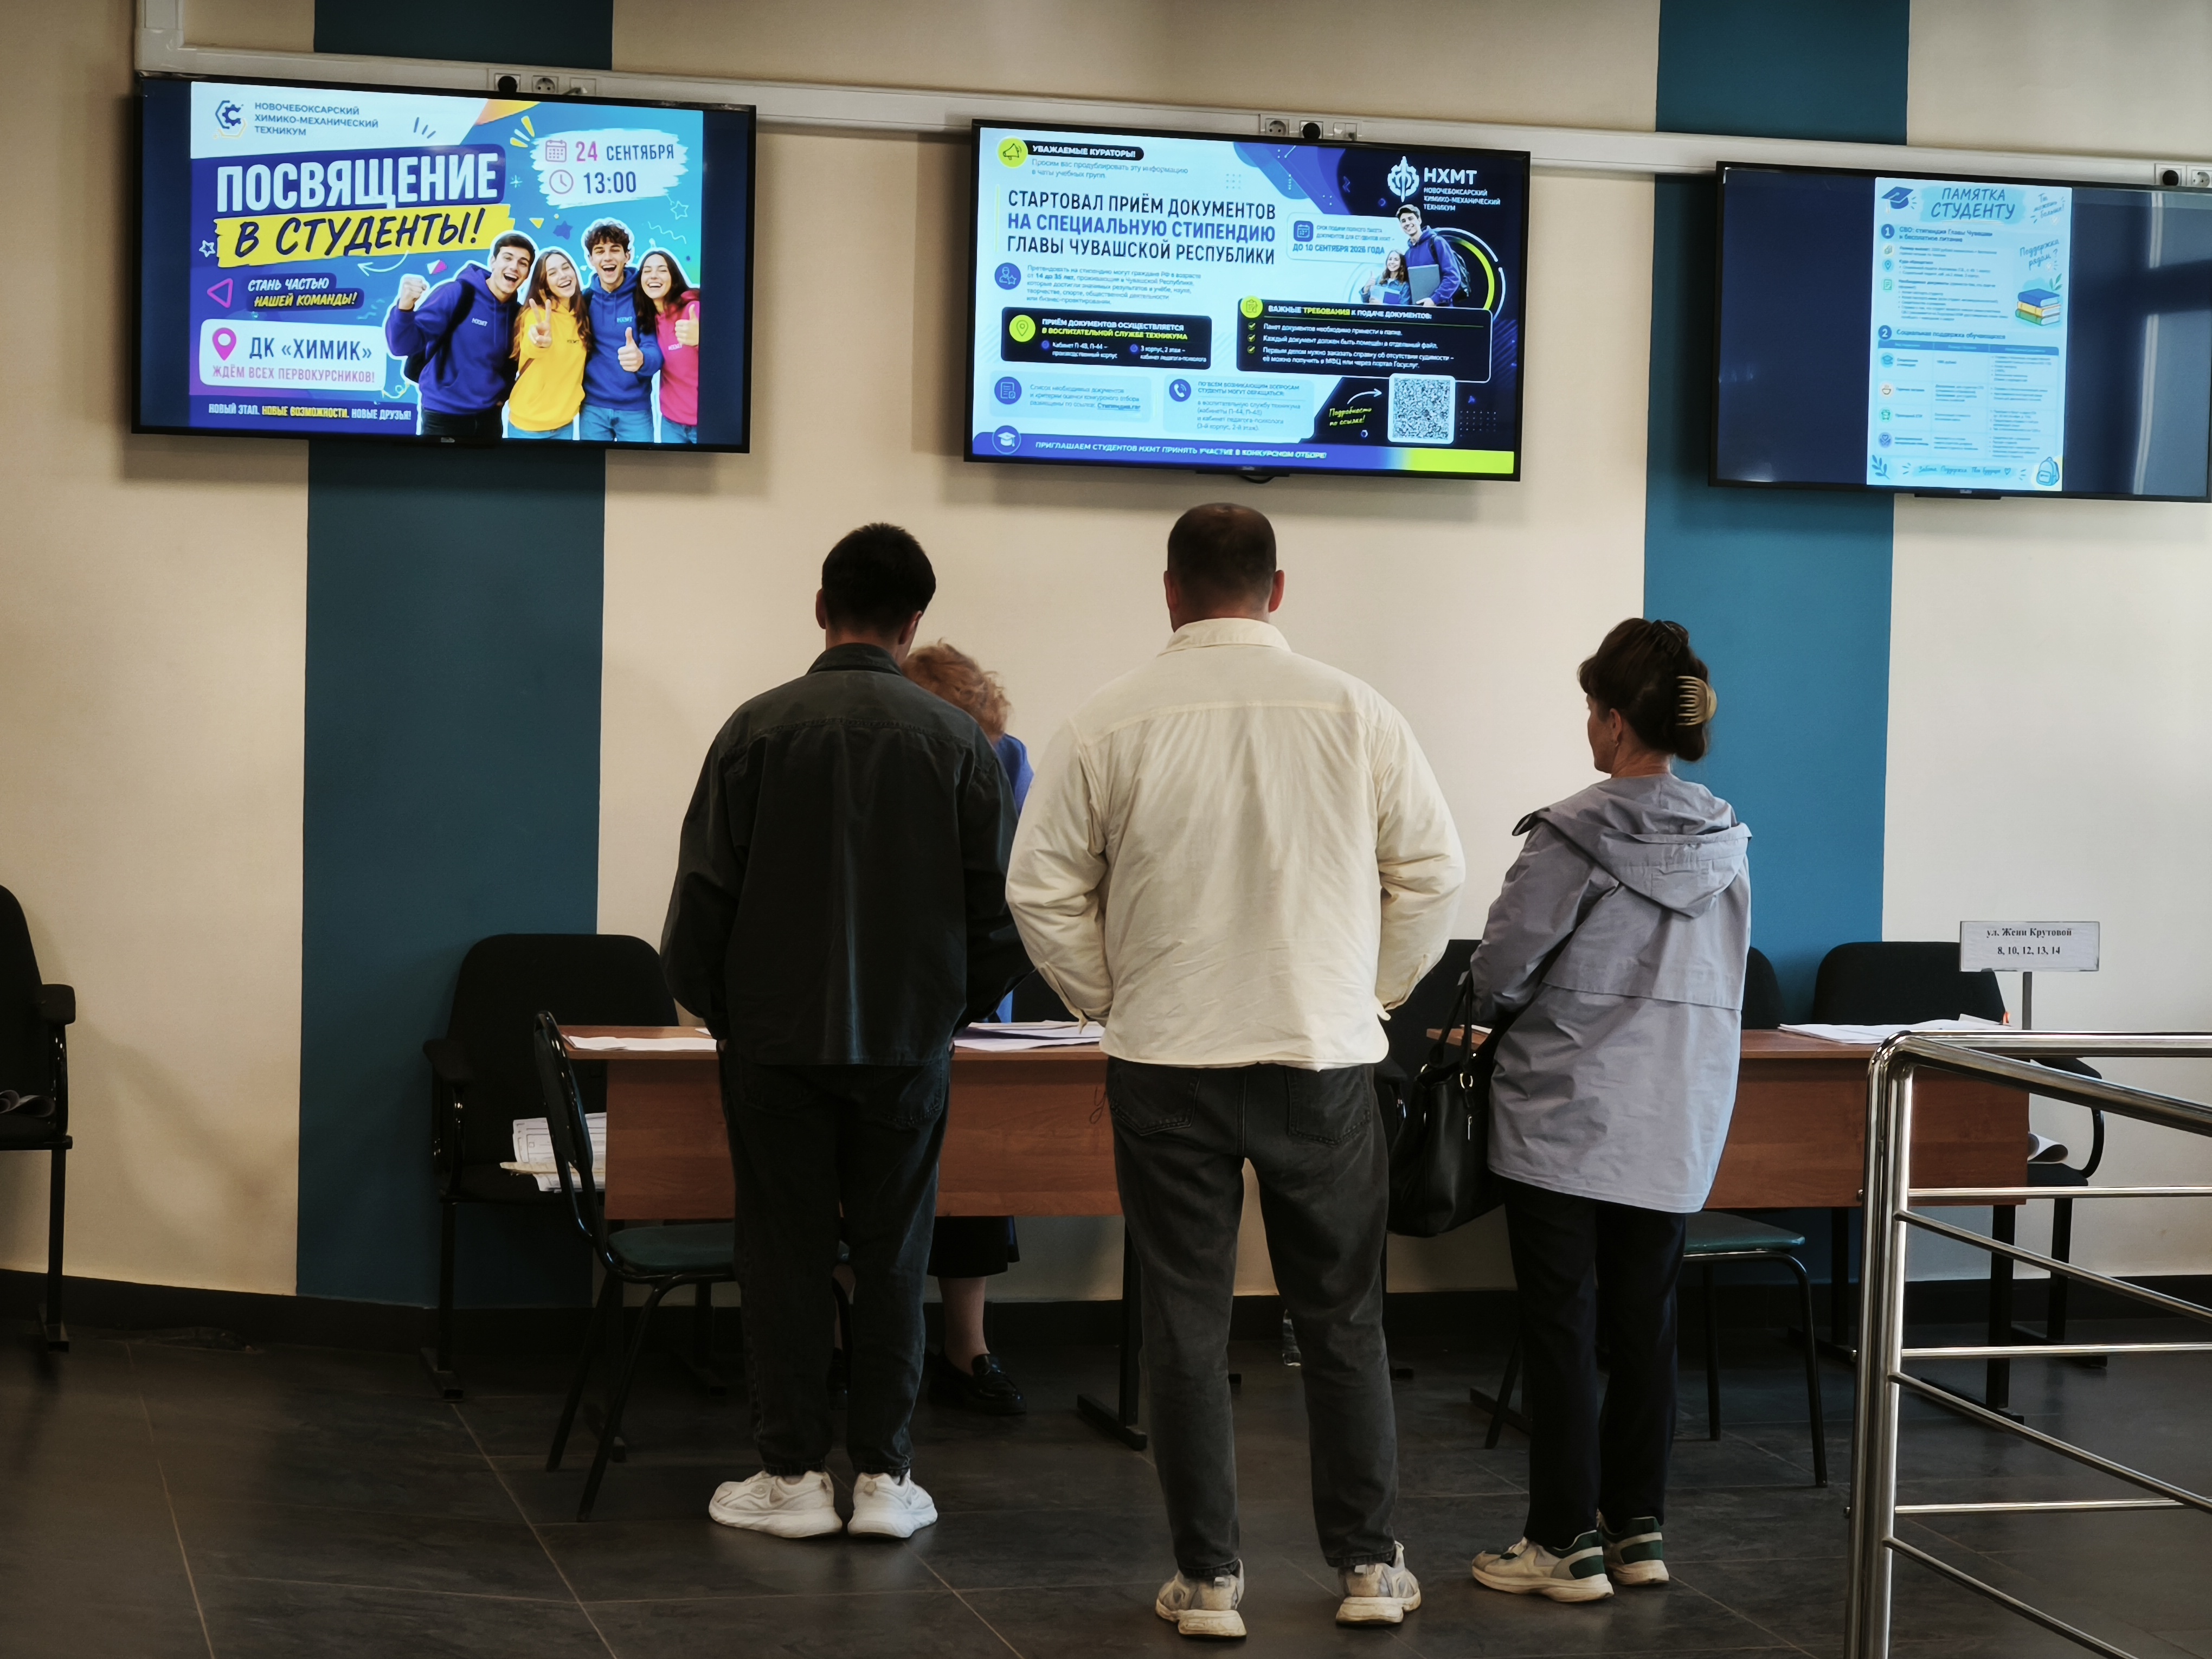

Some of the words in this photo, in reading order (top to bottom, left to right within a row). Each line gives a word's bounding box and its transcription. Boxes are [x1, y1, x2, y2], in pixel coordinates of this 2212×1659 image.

[255, 102, 359, 115] НОВОЧЕБОКСАРСКИЙ
[254, 114, 378, 128] ХИМИКО-МЕХАНИЧЕСКИЙ
[254, 125, 306, 136] ТЕХНИКУМ
[575, 141, 597, 162] 24
[606, 144, 674, 160] СЕНТЯБРЯ
[1032, 145, 1088, 156] УВАЖАЕМЫЕ
[1090, 147, 1136, 158] КУРАТОРЫ!
[1032, 159, 1059, 168] Просим
[1074, 163, 1129, 171] продублировать
[1143, 166, 1188, 174] информацию
[217, 152, 498, 212] ПОСВЯЩЕНИЕ
[583, 171, 636, 194] 13:00
[1424, 167, 1477, 185] НХМТ
[1423, 187, 1488, 196] НОВОЧЕБОКСАРСКИЙ
[1941, 187, 2005, 201] ПАМЯТКА
[1008, 190, 1103, 210] СТАРТОВАЛ
[1109, 194, 1163, 214] ПРИЁМ
[1167, 198, 1276, 220] ДОКУМЕНТОВ
[1423, 195, 1501, 205] ХИМИКО-МЕХАНИЧЕСКИЙ
[1931, 202, 2016, 220] СТУДЕНТУ
[235, 221, 259, 258] В
[275, 208, 486, 256] СТУДЕНТЫ!
[1008, 213, 1031, 229] НА
[1037, 214, 1167, 236] СПЕЦИАЛЬНУЮ
[1172, 221, 1276, 243] СТИПЕНДИЮ
[1885, 227, 1890, 236] 1
[1008, 235, 1064, 254] ГЛАВЫ
[1070, 239, 1171, 259] ЧУВАШСКОЙ
[1176, 244, 1275, 265] РЕСПУБЛИКИ
[1293, 243, 1303, 252] ДО
[1315, 244, 1348, 252] СЕНТЯБРЯ
[1367, 246, 1384, 254] ГОДА
[2019, 239, 2060, 258] Поддержка
[248, 279, 282, 291] СТАНЬ
[285, 278, 330, 290] ЧАСТЬЮ
[254, 293, 293, 307] НАШЕЙ
[296, 292, 357, 306] КОМАНДЫ!
[1303, 307, 1350, 316] ТРЕБОВАНИЯ
[1042, 318, 1067, 326] ПРИЁМ
[1068, 320, 1117, 328] ДОКУМЕНТОВ
[1117, 322, 1184, 331] ОСУЩЕСТВЛЯЕТСЯ
[1048, 327, 1113, 337] ВОСПИТАТЕЛЬНОЙ
[1145, 332, 1188, 340] ТЕХНИКУМА
[1882, 328, 1888, 337] 2
[249, 337, 275, 359] ДК
[281, 338, 372, 361] «ХИМИК»
[212, 364, 245, 378] ЖДЁМ
[248, 366, 274, 379] ВСЕХ
[278, 368, 375, 383] ПЕРВОКУРСНИКОВ!
[209, 403, 236, 414] НОВЫЙ
[238, 405, 260, 415] ЭТАП.
[262, 406, 288, 416] НОВЫЕ
[290, 406, 350, 418] ВОЗМОЖНОСТИ.
[351, 409, 378, 419] НОВЫЕ
[380, 409, 411, 420] ДРУЗЬЯ!
[1036, 441, 1091, 450] ПРИГЛАШАЕМ
[1092, 443, 1137, 452] СТУДЕНТОВ
[1162, 446, 1197, 454] ПРИНЯТЬ
[1242, 449, 1294, 458] КОНКУРСНОМ
[1986, 930, 1999, 938] ул.
[2002, 928, 2027, 936] Жени
[2030, 928, 2072, 938] Крутовой
[1997, 947, 2005, 955] 8,
[2008, 947, 2019, 955] 10,
[2023, 947, 2034, 955] 12,
[2037, 947, 2048, 955] 13,
